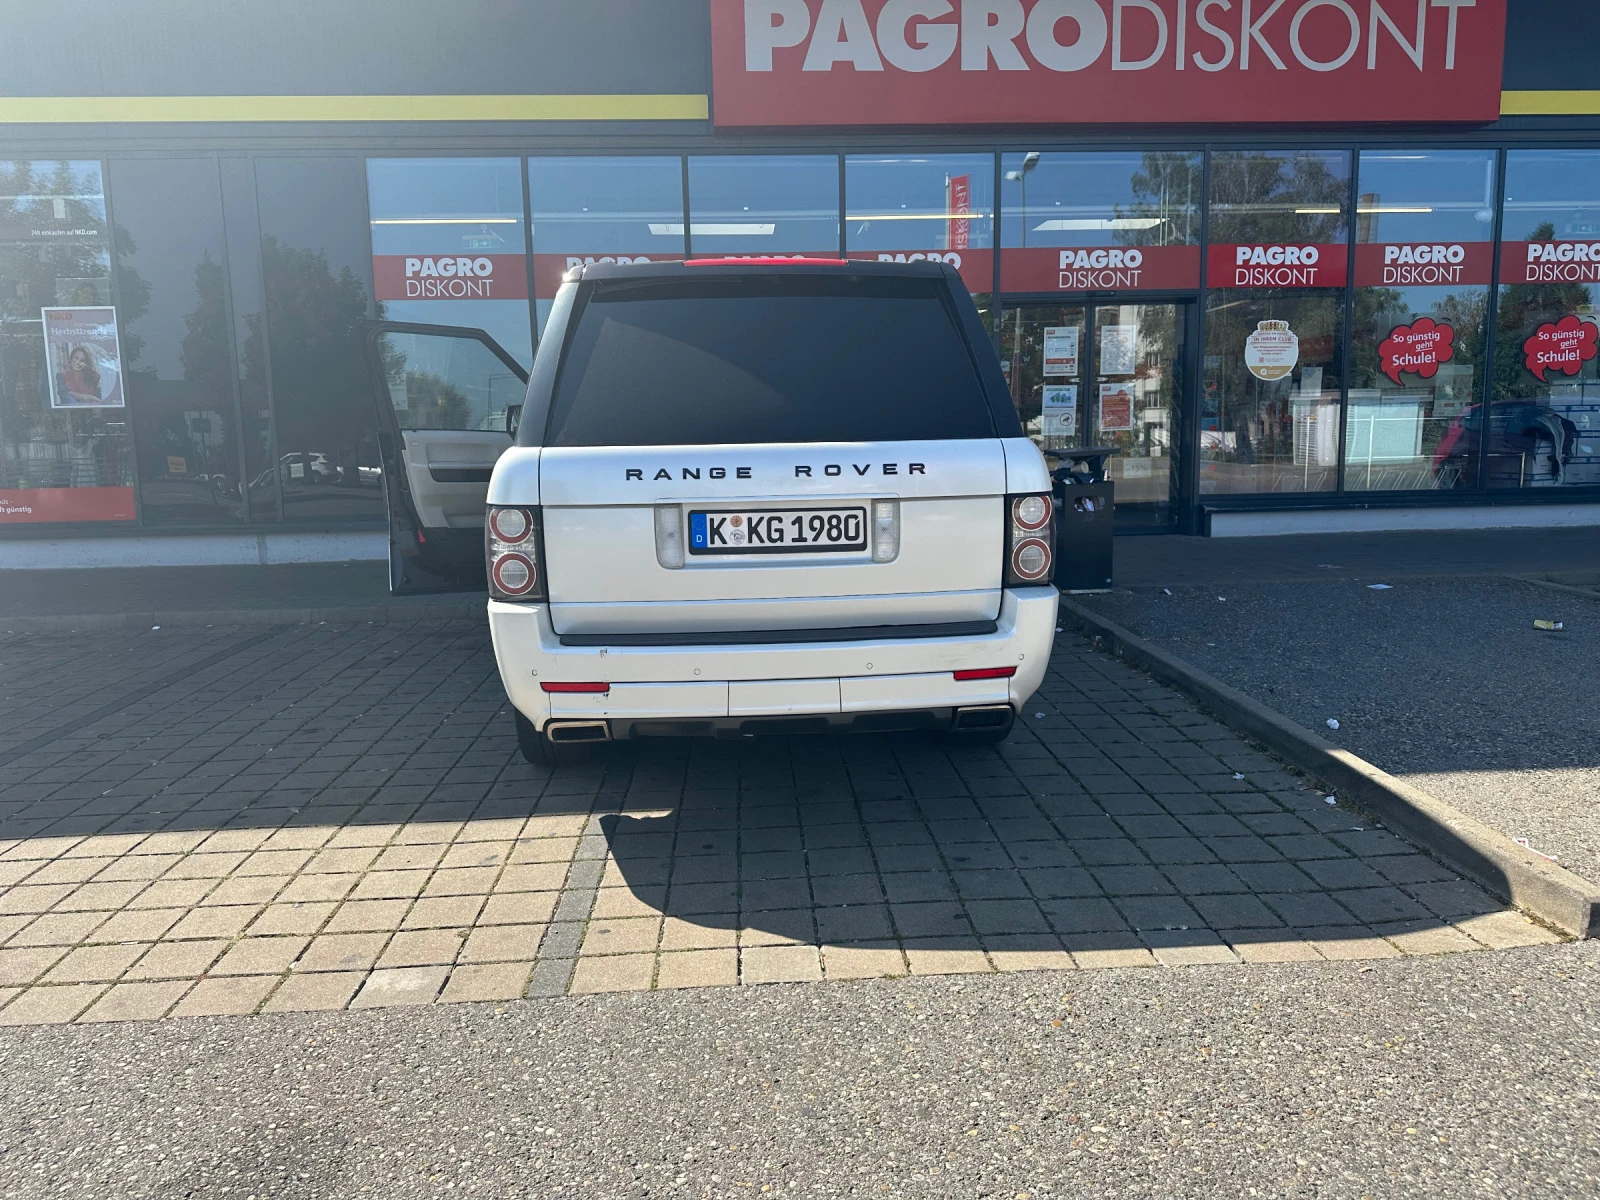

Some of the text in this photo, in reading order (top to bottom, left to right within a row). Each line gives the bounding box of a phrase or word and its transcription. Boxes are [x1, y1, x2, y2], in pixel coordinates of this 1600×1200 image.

[1059, 249, 1143, 269] PAGRO
[1236, 246, 1319, 265] PAGRO
[1384, 245, 1465, 264] PAGRO
[1527, 243, 1600, 262] PAGRO
[405, 257, 493, 277] PAGRO
[1383, 265, 1464, 283] DISKONT
[1058, 270, 1142, 288] DISKONT
[1235, 268, 1318, 285] DISKONT
[406, 280, 493, 297] DISKONT
[1393, 331, 1440, 344] So günstig
[1538, 329, 1585, 341] So günstig
[1560, 339, 1578, 348] geht
[1415, 341, 1433, 351] geht
[1392, 352, 1436, 366] Schule!
[1537, 349, 1580, 363] Schule!
[625, 463, 926, 481] RANGE ROVER
[6, 505, 32, 514] günstig
[696, 534, 702, 542] D
